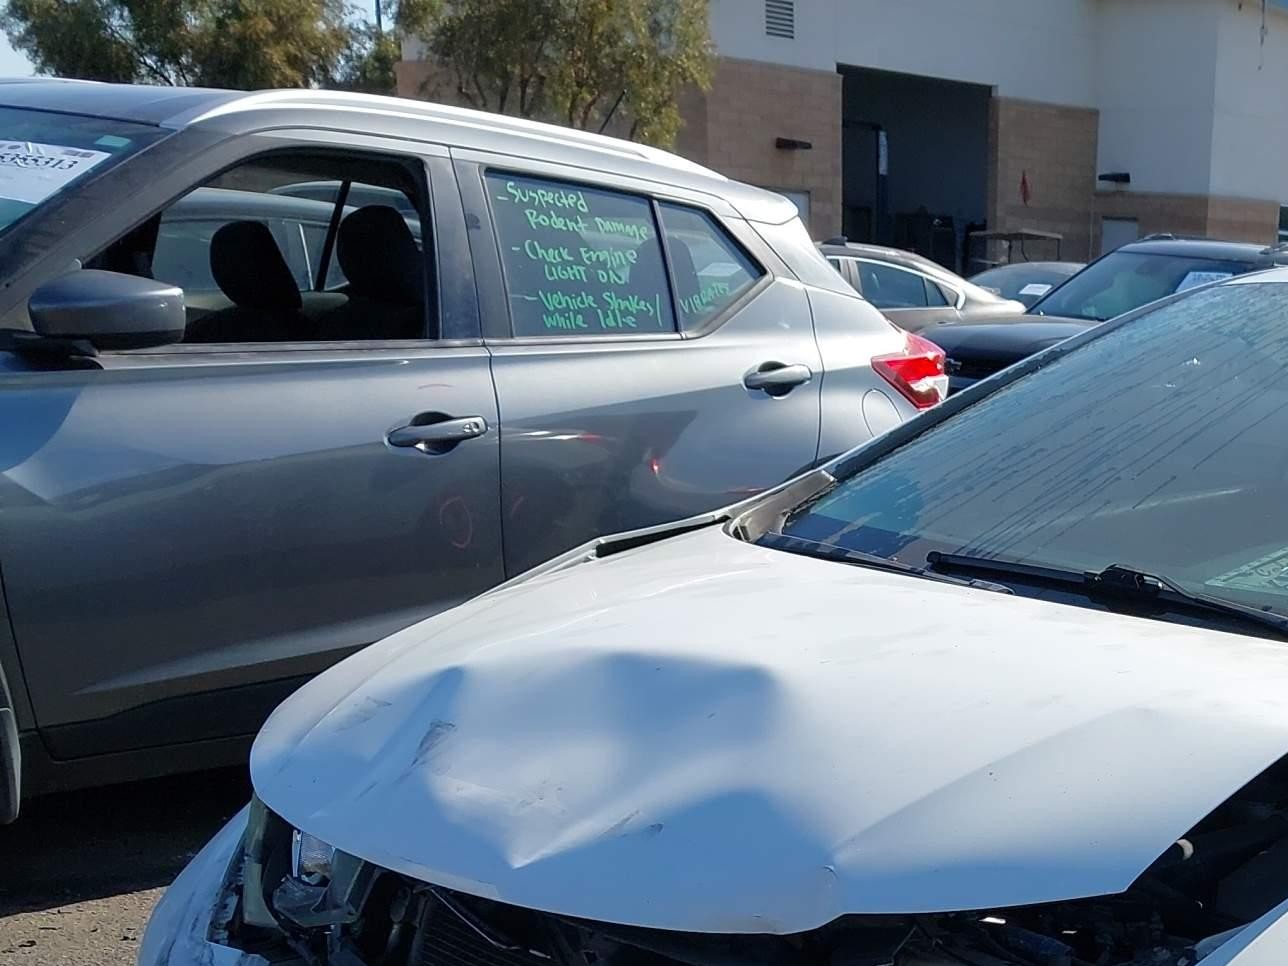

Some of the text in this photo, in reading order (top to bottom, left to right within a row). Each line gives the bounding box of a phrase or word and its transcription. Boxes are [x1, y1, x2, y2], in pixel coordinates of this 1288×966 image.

[506, 181, 589, 213] Suspected
[525, 209, 589, 233] Rodent
[524, 239, 574, 264] Check
[580, 247, 638, 269] Engine
[544, 265, 626, 285] LIGHT ON
[538, 290, 597, 311] Vehicle
